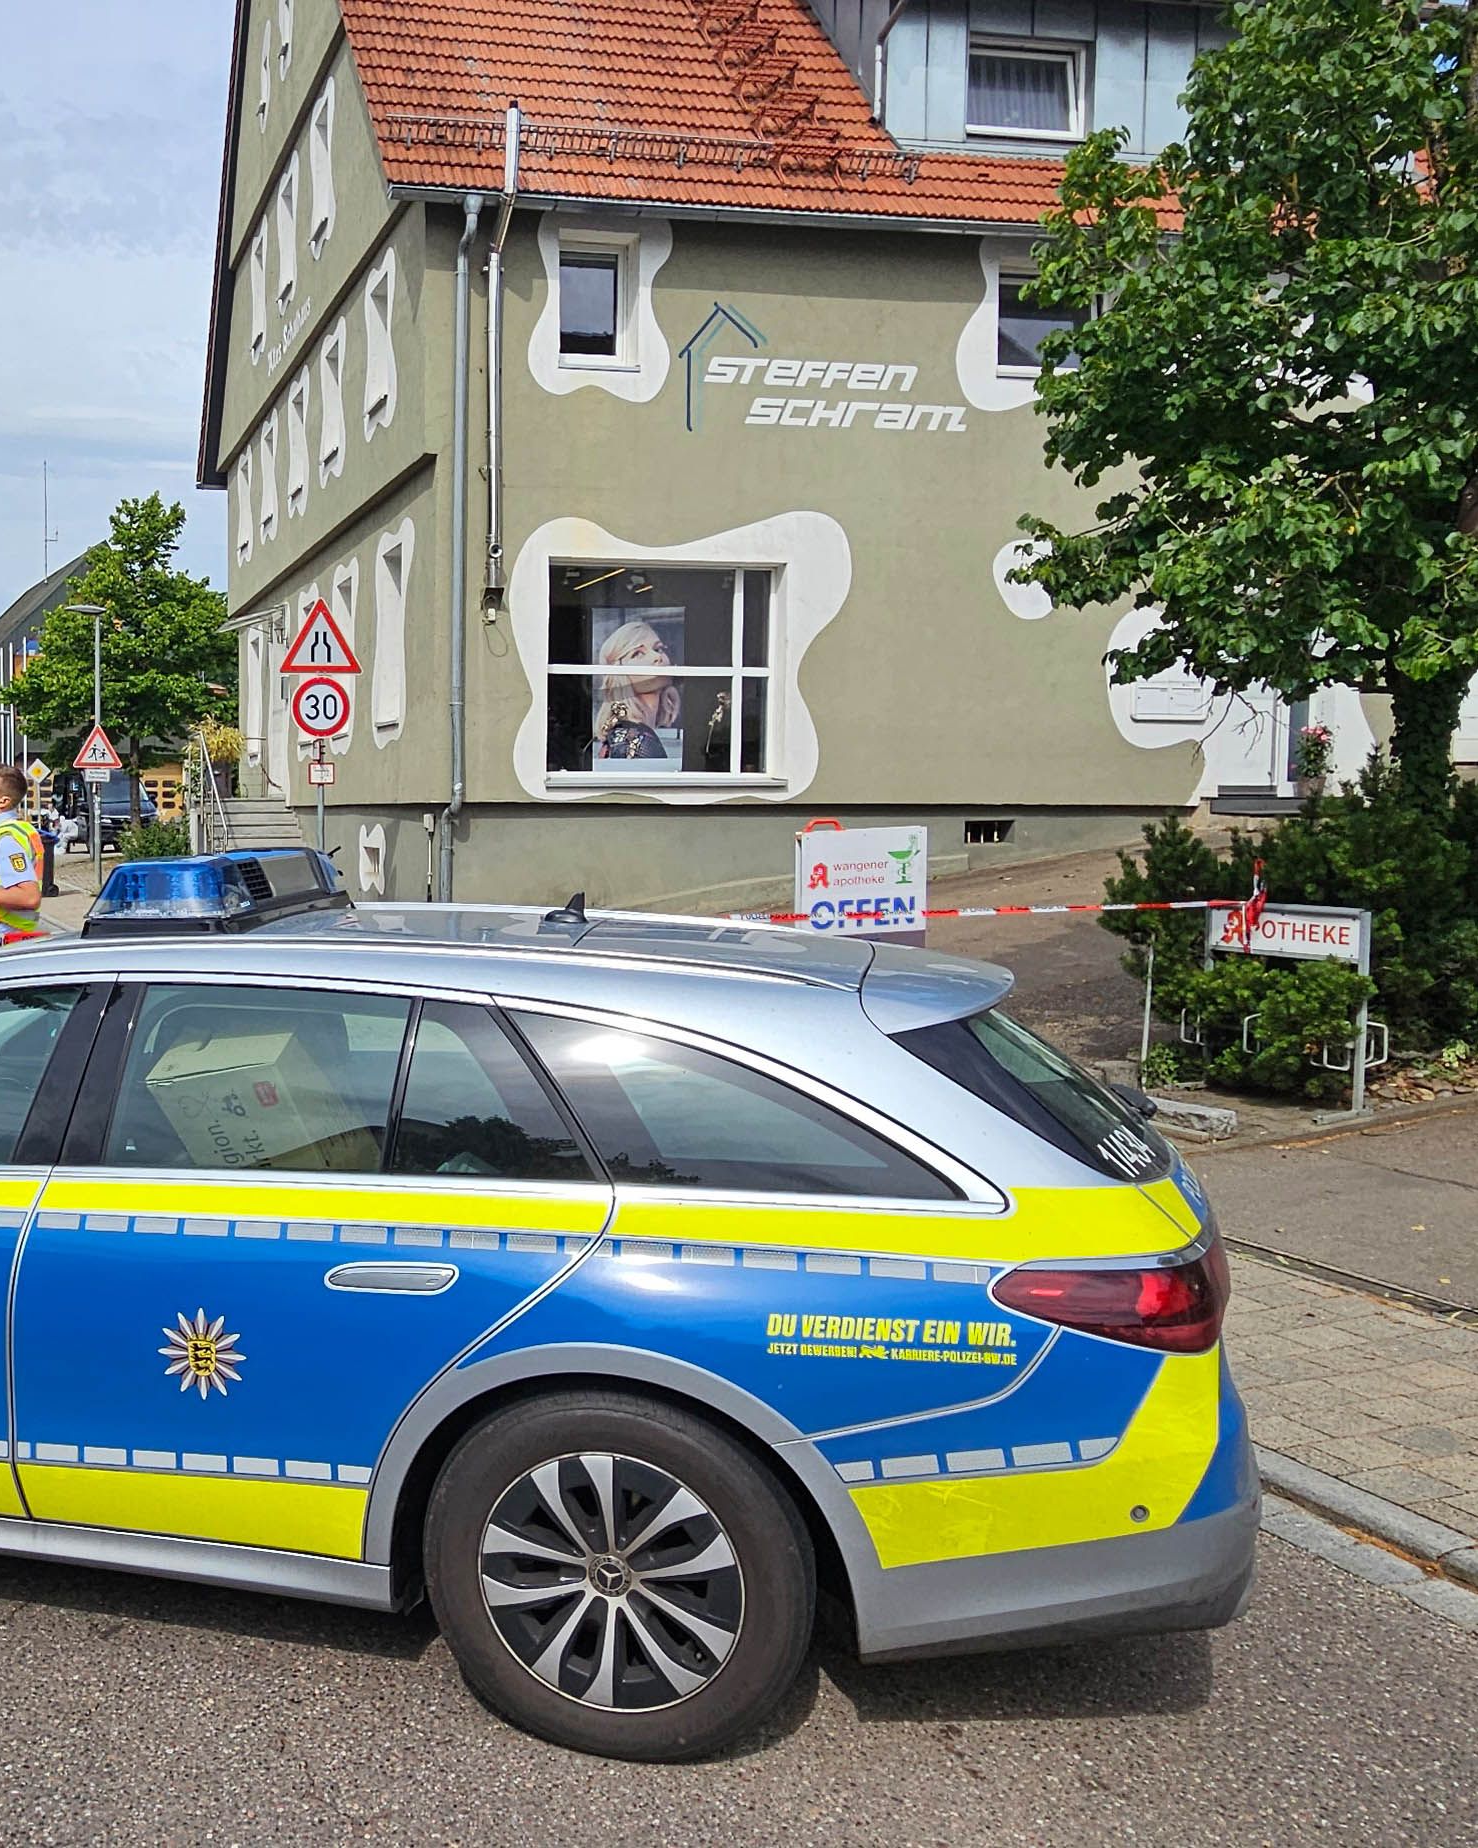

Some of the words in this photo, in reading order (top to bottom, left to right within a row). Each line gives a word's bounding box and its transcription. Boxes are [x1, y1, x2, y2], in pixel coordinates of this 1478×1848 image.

[305, 694, 337, 721] 30
[833, 860, 889, 873] wangener
[833, 875, 886, 887] apotheke
[810, 896, 916, 930] OFFEN
[767, 1313, 797, 1337] DU
[800, 1315, 920, 1344] VERDIENST
[922, 1320, 961, 1344] EIN
[967, 1322, 1017, 1347] WIR.
[767, 1343, 798, 1355] JETZT
[800, 1345, 857, 1358] BEWERBEN!
[891, 1348, 1017, 1366] KARRIERE-POLIZEI-BW.DE
